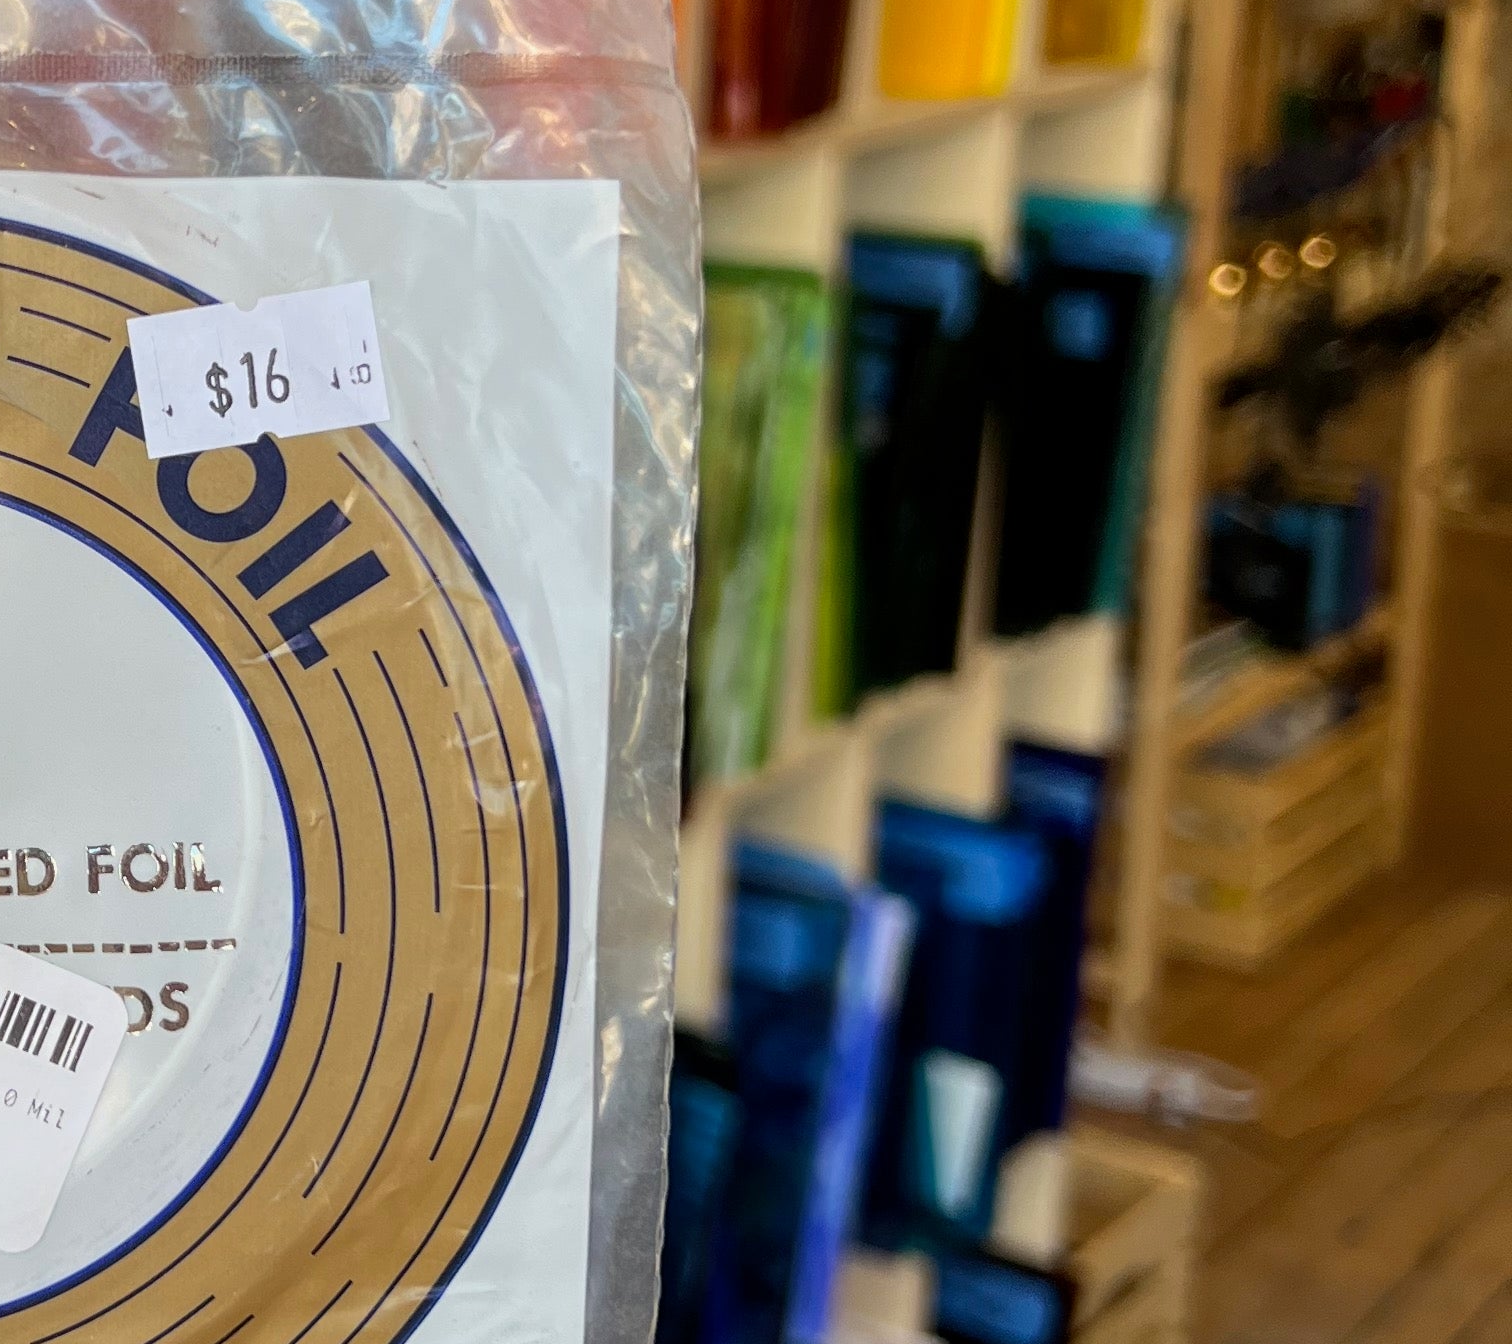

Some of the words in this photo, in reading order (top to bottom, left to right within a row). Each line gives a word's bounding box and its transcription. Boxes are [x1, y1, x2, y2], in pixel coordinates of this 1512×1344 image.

[205, 348, 290, 418] $16
[68, 346, 390, 670] FOIL
[86, 841, 225, 895] FOIL
[26, 1098, 66, 1130] Mil
